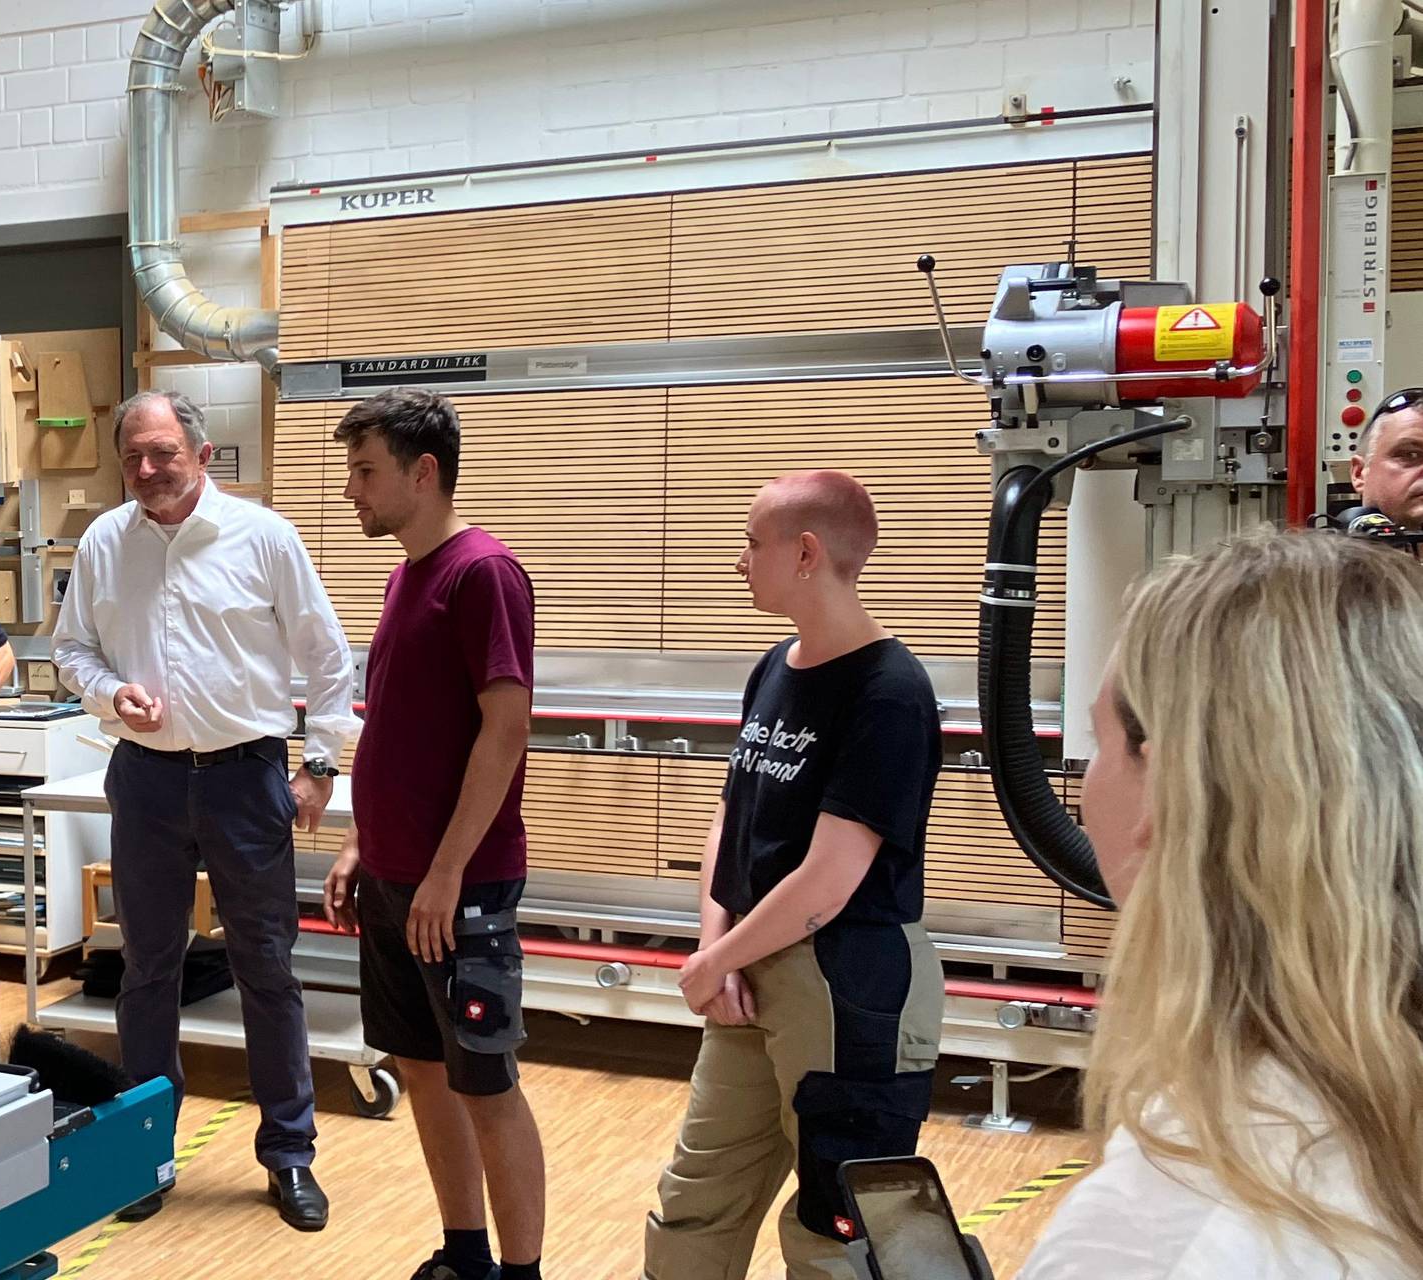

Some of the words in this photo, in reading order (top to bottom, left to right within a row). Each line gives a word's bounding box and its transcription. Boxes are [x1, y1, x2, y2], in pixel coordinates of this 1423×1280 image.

[340, 188, 436, 211] KUPER
[1363, 196, 1378, 298] STRIEBIG
[348, 359, 430, 373] STANDARD
[435, 358, 449, 368] III
[455, 356, 481, 367] TRK
[740, 714, 770, 744] eine
